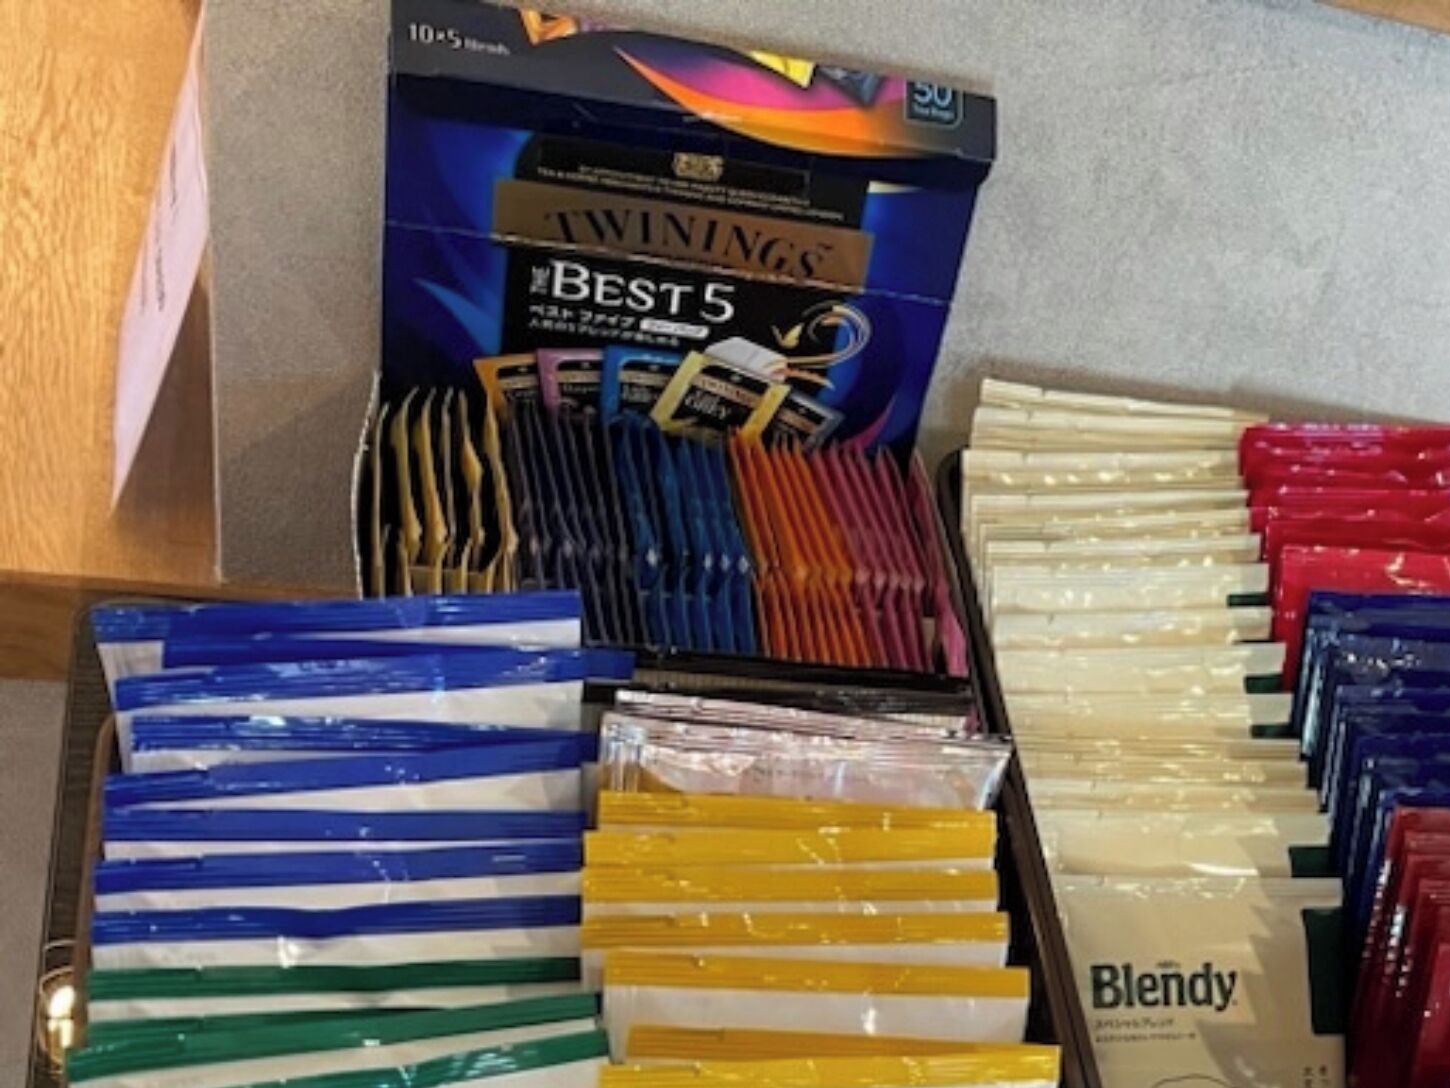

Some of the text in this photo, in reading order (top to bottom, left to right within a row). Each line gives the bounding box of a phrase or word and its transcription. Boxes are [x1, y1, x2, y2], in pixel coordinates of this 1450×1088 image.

[545, 207, 824, 278] TWININGS
[551, 259, 735, 324] BEST 5
[1090, 962, 1239, 1012] Blendy
